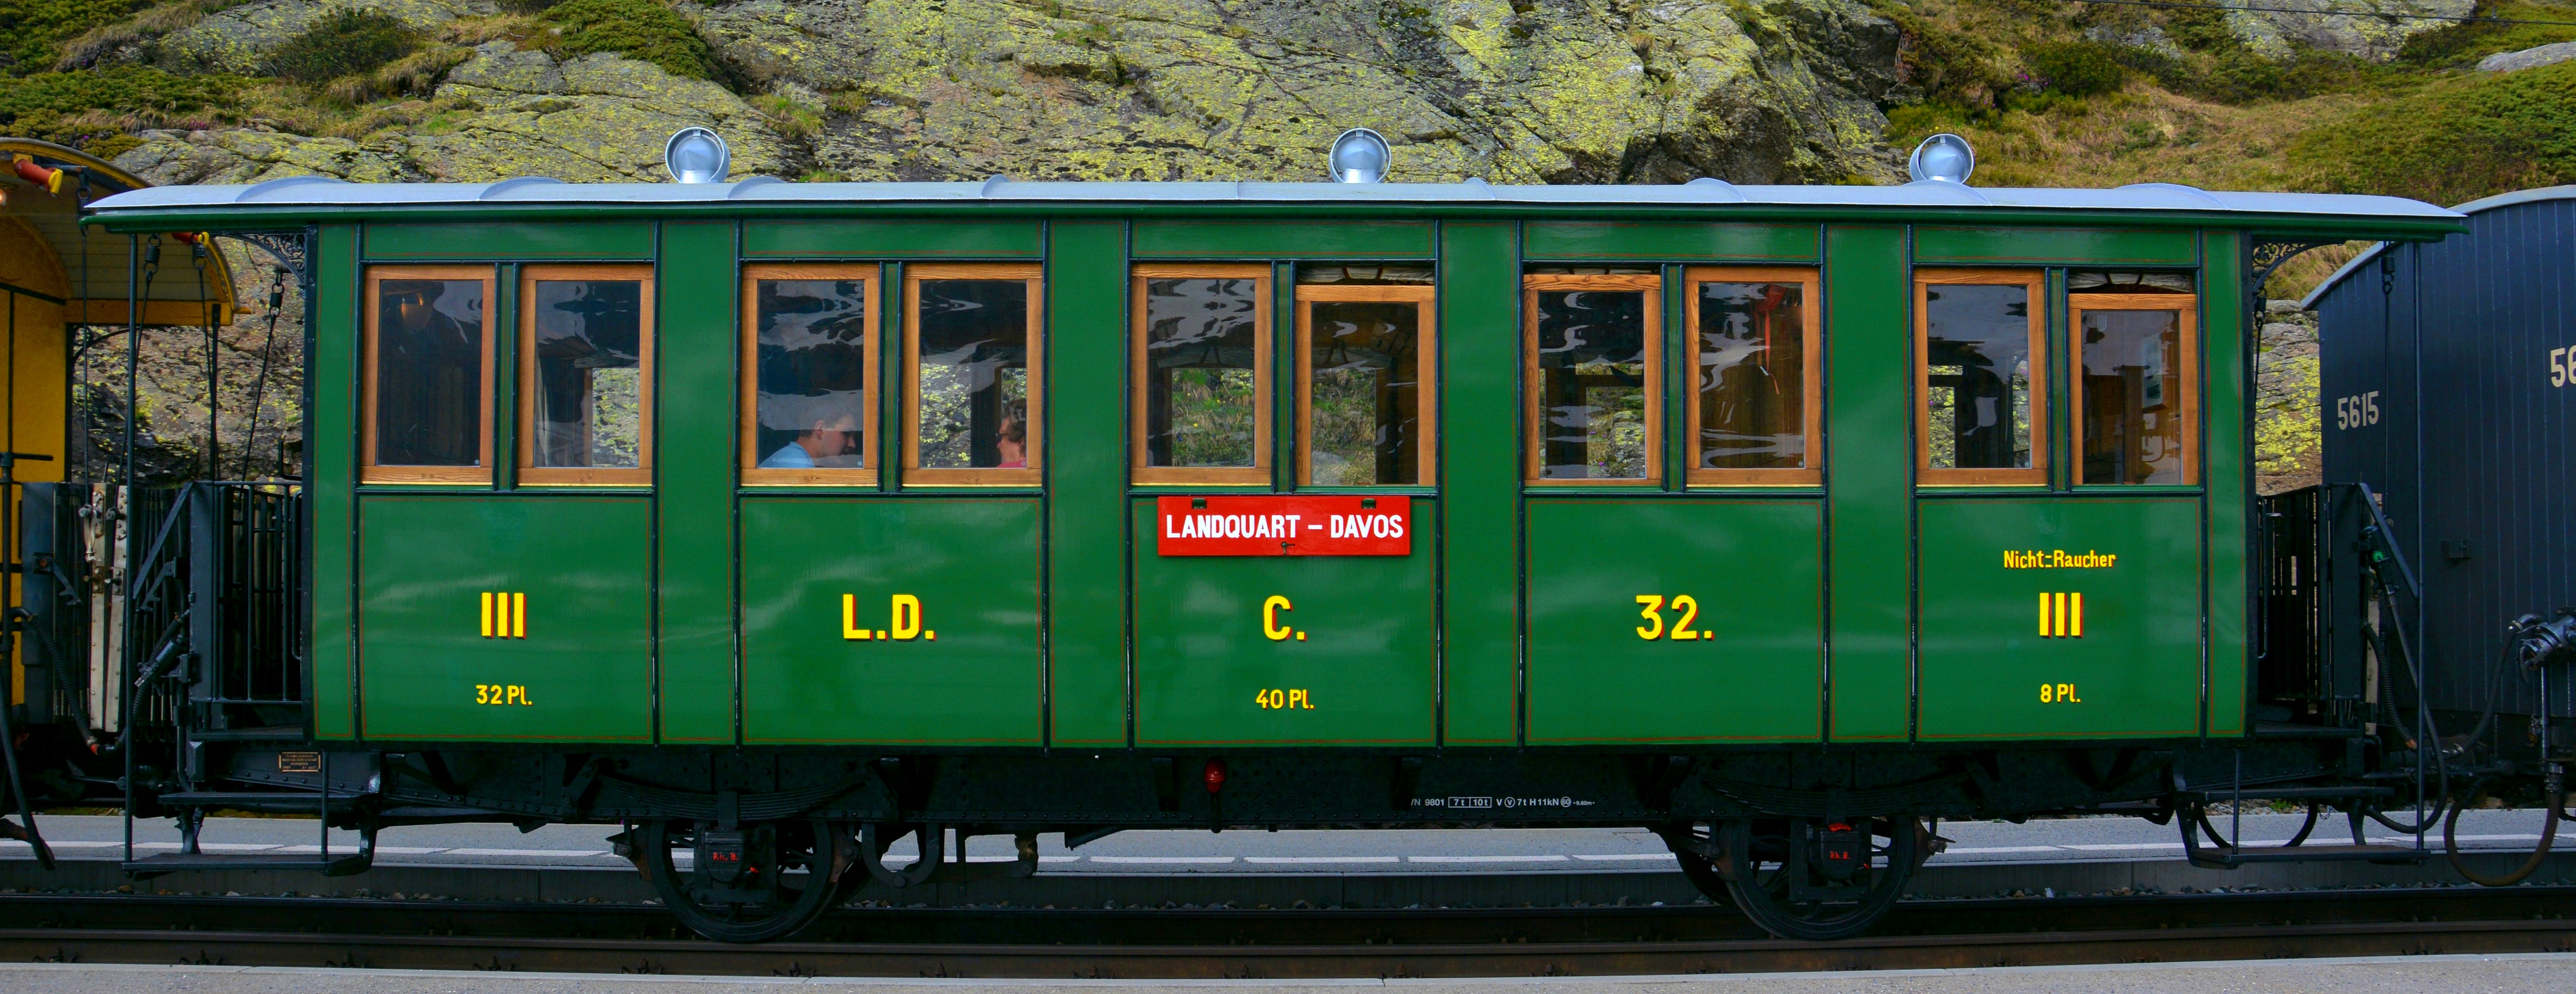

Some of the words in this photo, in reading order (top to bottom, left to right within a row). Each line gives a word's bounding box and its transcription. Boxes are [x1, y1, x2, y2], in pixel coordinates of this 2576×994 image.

[2337, 391, 2379, 431] 5615
[1167, 515, 1300, 539] LANDQUART
[1330, 515, 1404, 538] DAVOS
[480, 592, 527, 639] III
[842, 594, 937, 642] L.D.
[1263, 595, 1308, 642] C.
[1636, 594, 1715, 641] 32.
[2039, 592, 2084, 638] III
[476, 684, 503, 705] 32
[507, 685, 533, 706] Pl.
[1256, 689, 1285, 710] 40
[1289, 689, 1315, 710] Pl.
[2040, 683, 2053, 703] 8
[2057, 683, 2082, 703] Pl.
